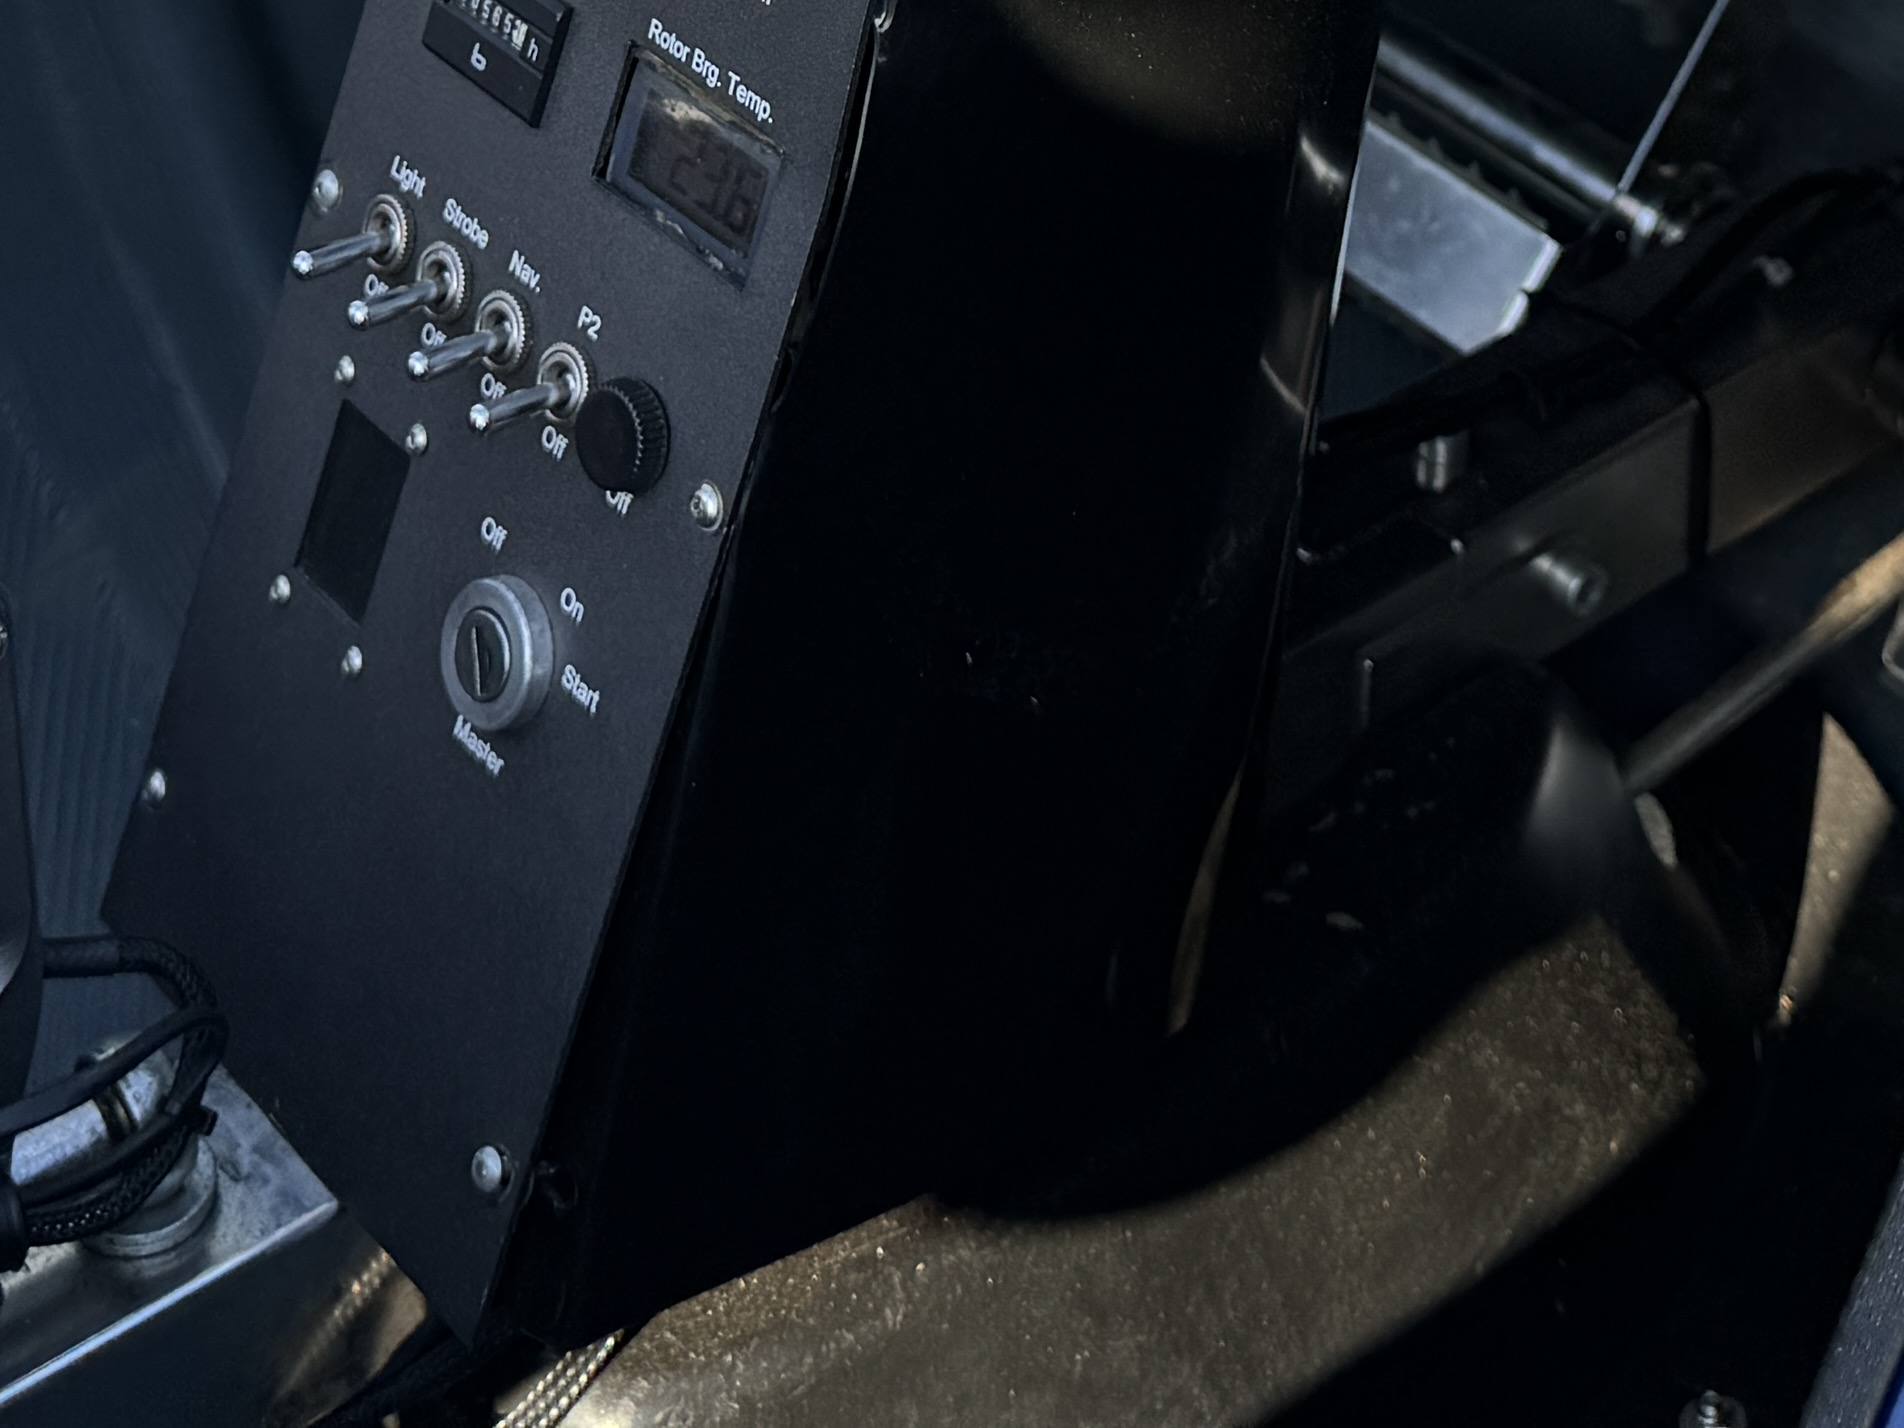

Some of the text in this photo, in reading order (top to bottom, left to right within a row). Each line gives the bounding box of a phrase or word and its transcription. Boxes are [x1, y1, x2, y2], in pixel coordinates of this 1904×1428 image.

[527, 37, 539, 62] h
[647, 17, 774, 124] Rotor Brg. Temp.
[389, 154, 427, 200] Light
[443, 197, 490, 250] Strobe
[508, 249, 542, 294] Nav.
[577, 304, 603, 342] P2
[541, 424, 570, 461] Off
[479, 515, 508, 552] Off
[559, 587, 586, 624] On
[560, 664, 600, 717] Start
[451, 713, 506, 778] Master
